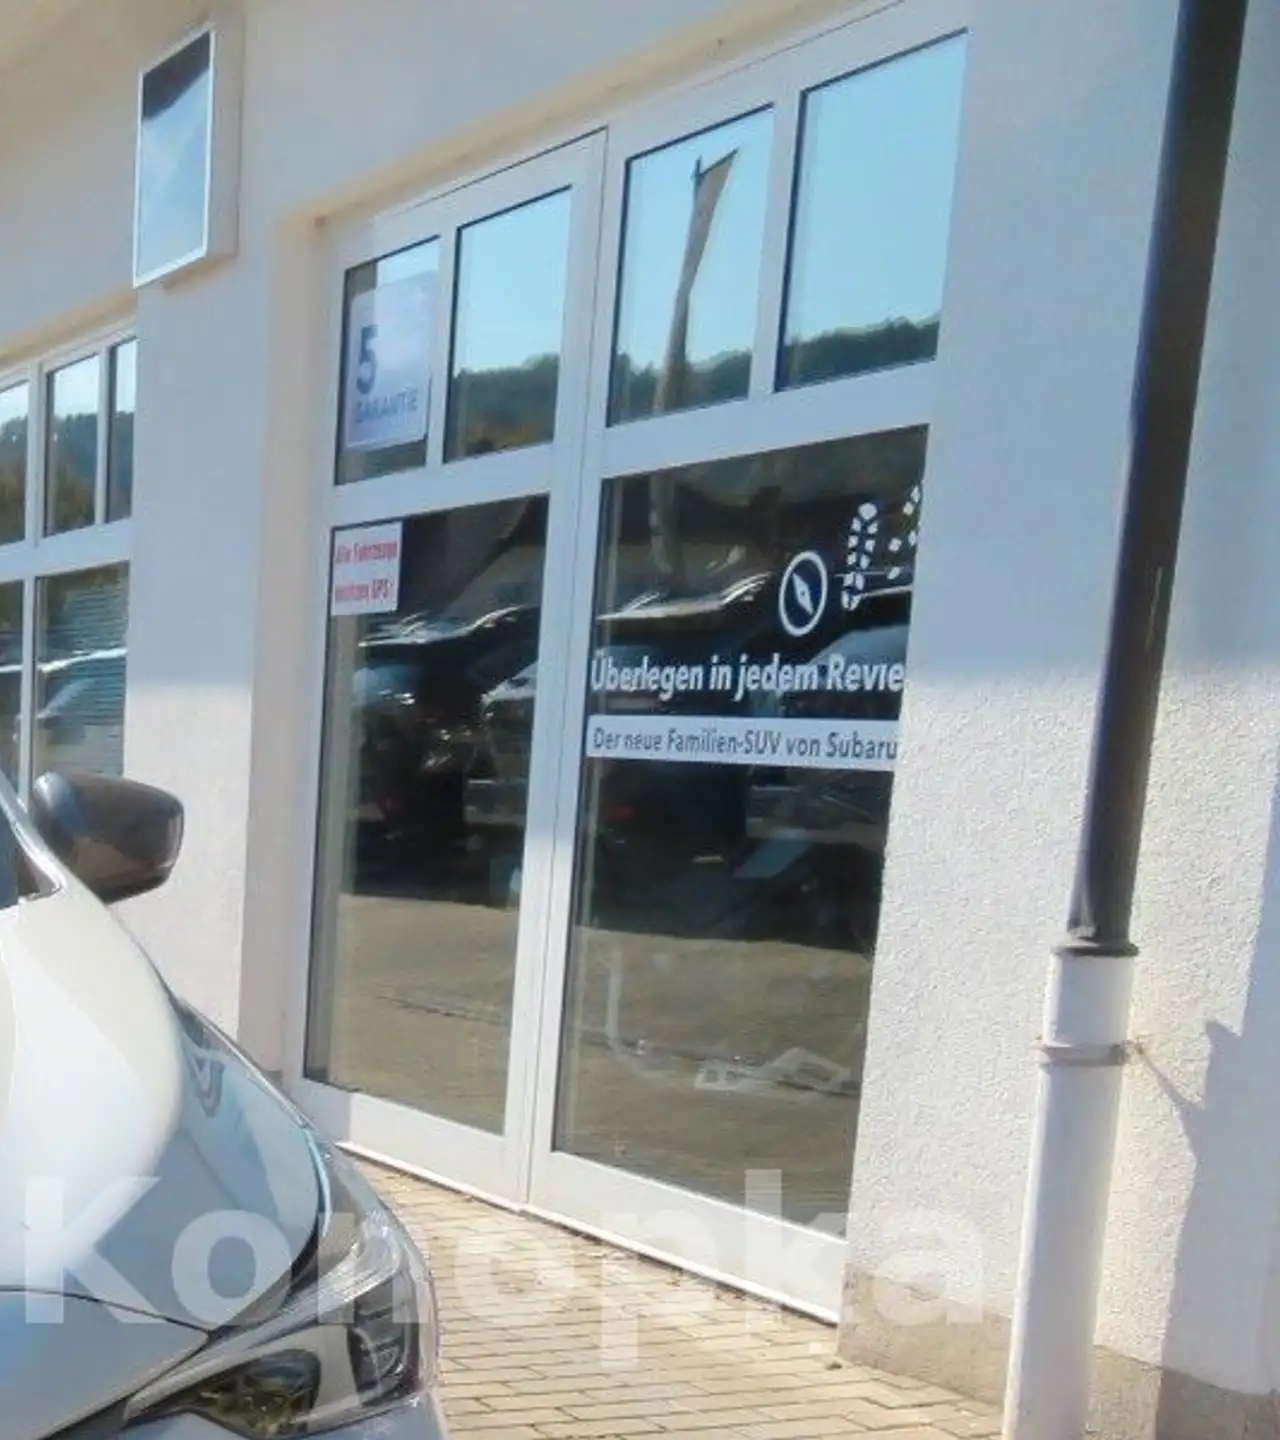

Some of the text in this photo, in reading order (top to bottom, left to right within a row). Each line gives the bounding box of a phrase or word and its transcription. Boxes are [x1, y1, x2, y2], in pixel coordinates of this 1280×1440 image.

[356, 324, 379, 394] 5
[591, 650, 703, 700] Überlegen
[708, 654, 732, 690] in
[734, 653, 818, 701] jedem
[593, 727, 897, 759] Der neue Familien-SUV von Subaru
